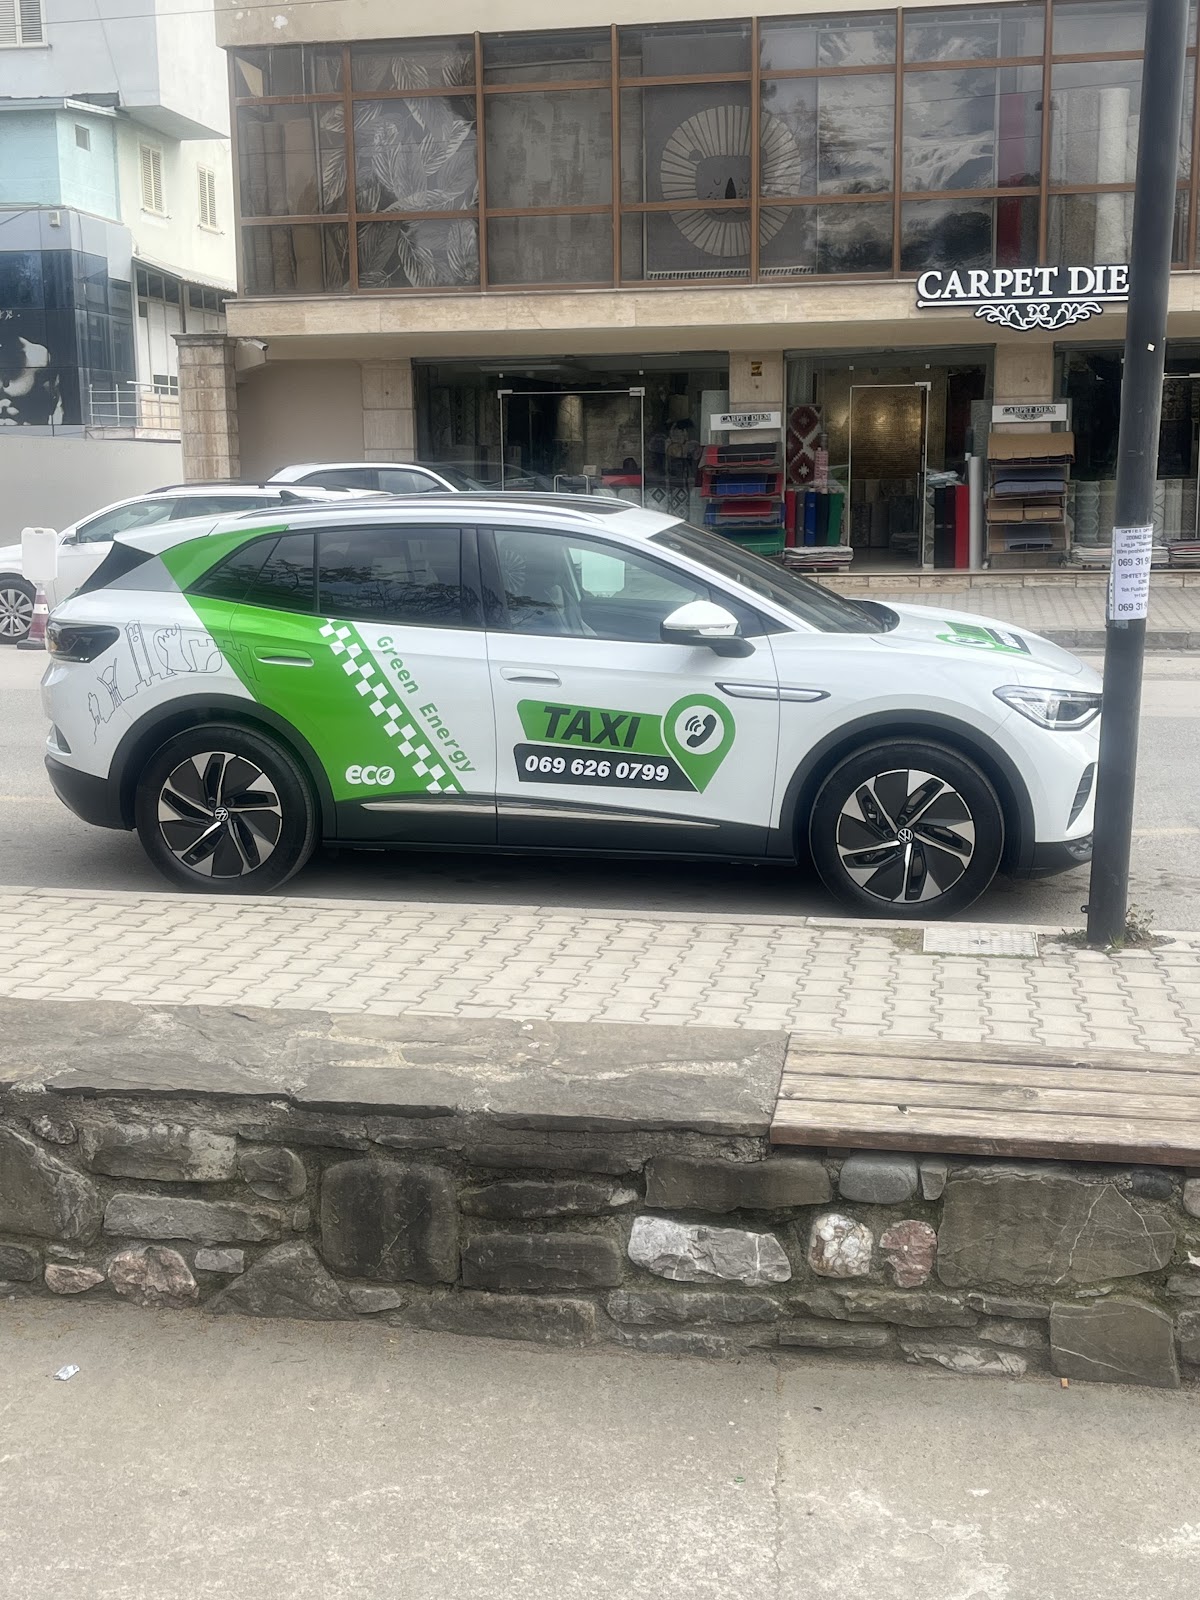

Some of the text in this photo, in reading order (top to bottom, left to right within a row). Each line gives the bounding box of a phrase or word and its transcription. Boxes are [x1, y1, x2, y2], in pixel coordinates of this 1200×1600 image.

[917, 265, 1130, 299] CARPET DIE
[720, 413, 771, 423] CARPET DIEM
[1003, 406, 1034, 414] CARPET
[1118, 558, 1133, 567] 069
[1118, 602, 1134, 612] 069
[377, 636, 476, 773] Green Energy
[543, 705, 641, 748] TAXI
[345, 764, 395, 786] eco
[524, 755, 669, 782] 069 626 0799
